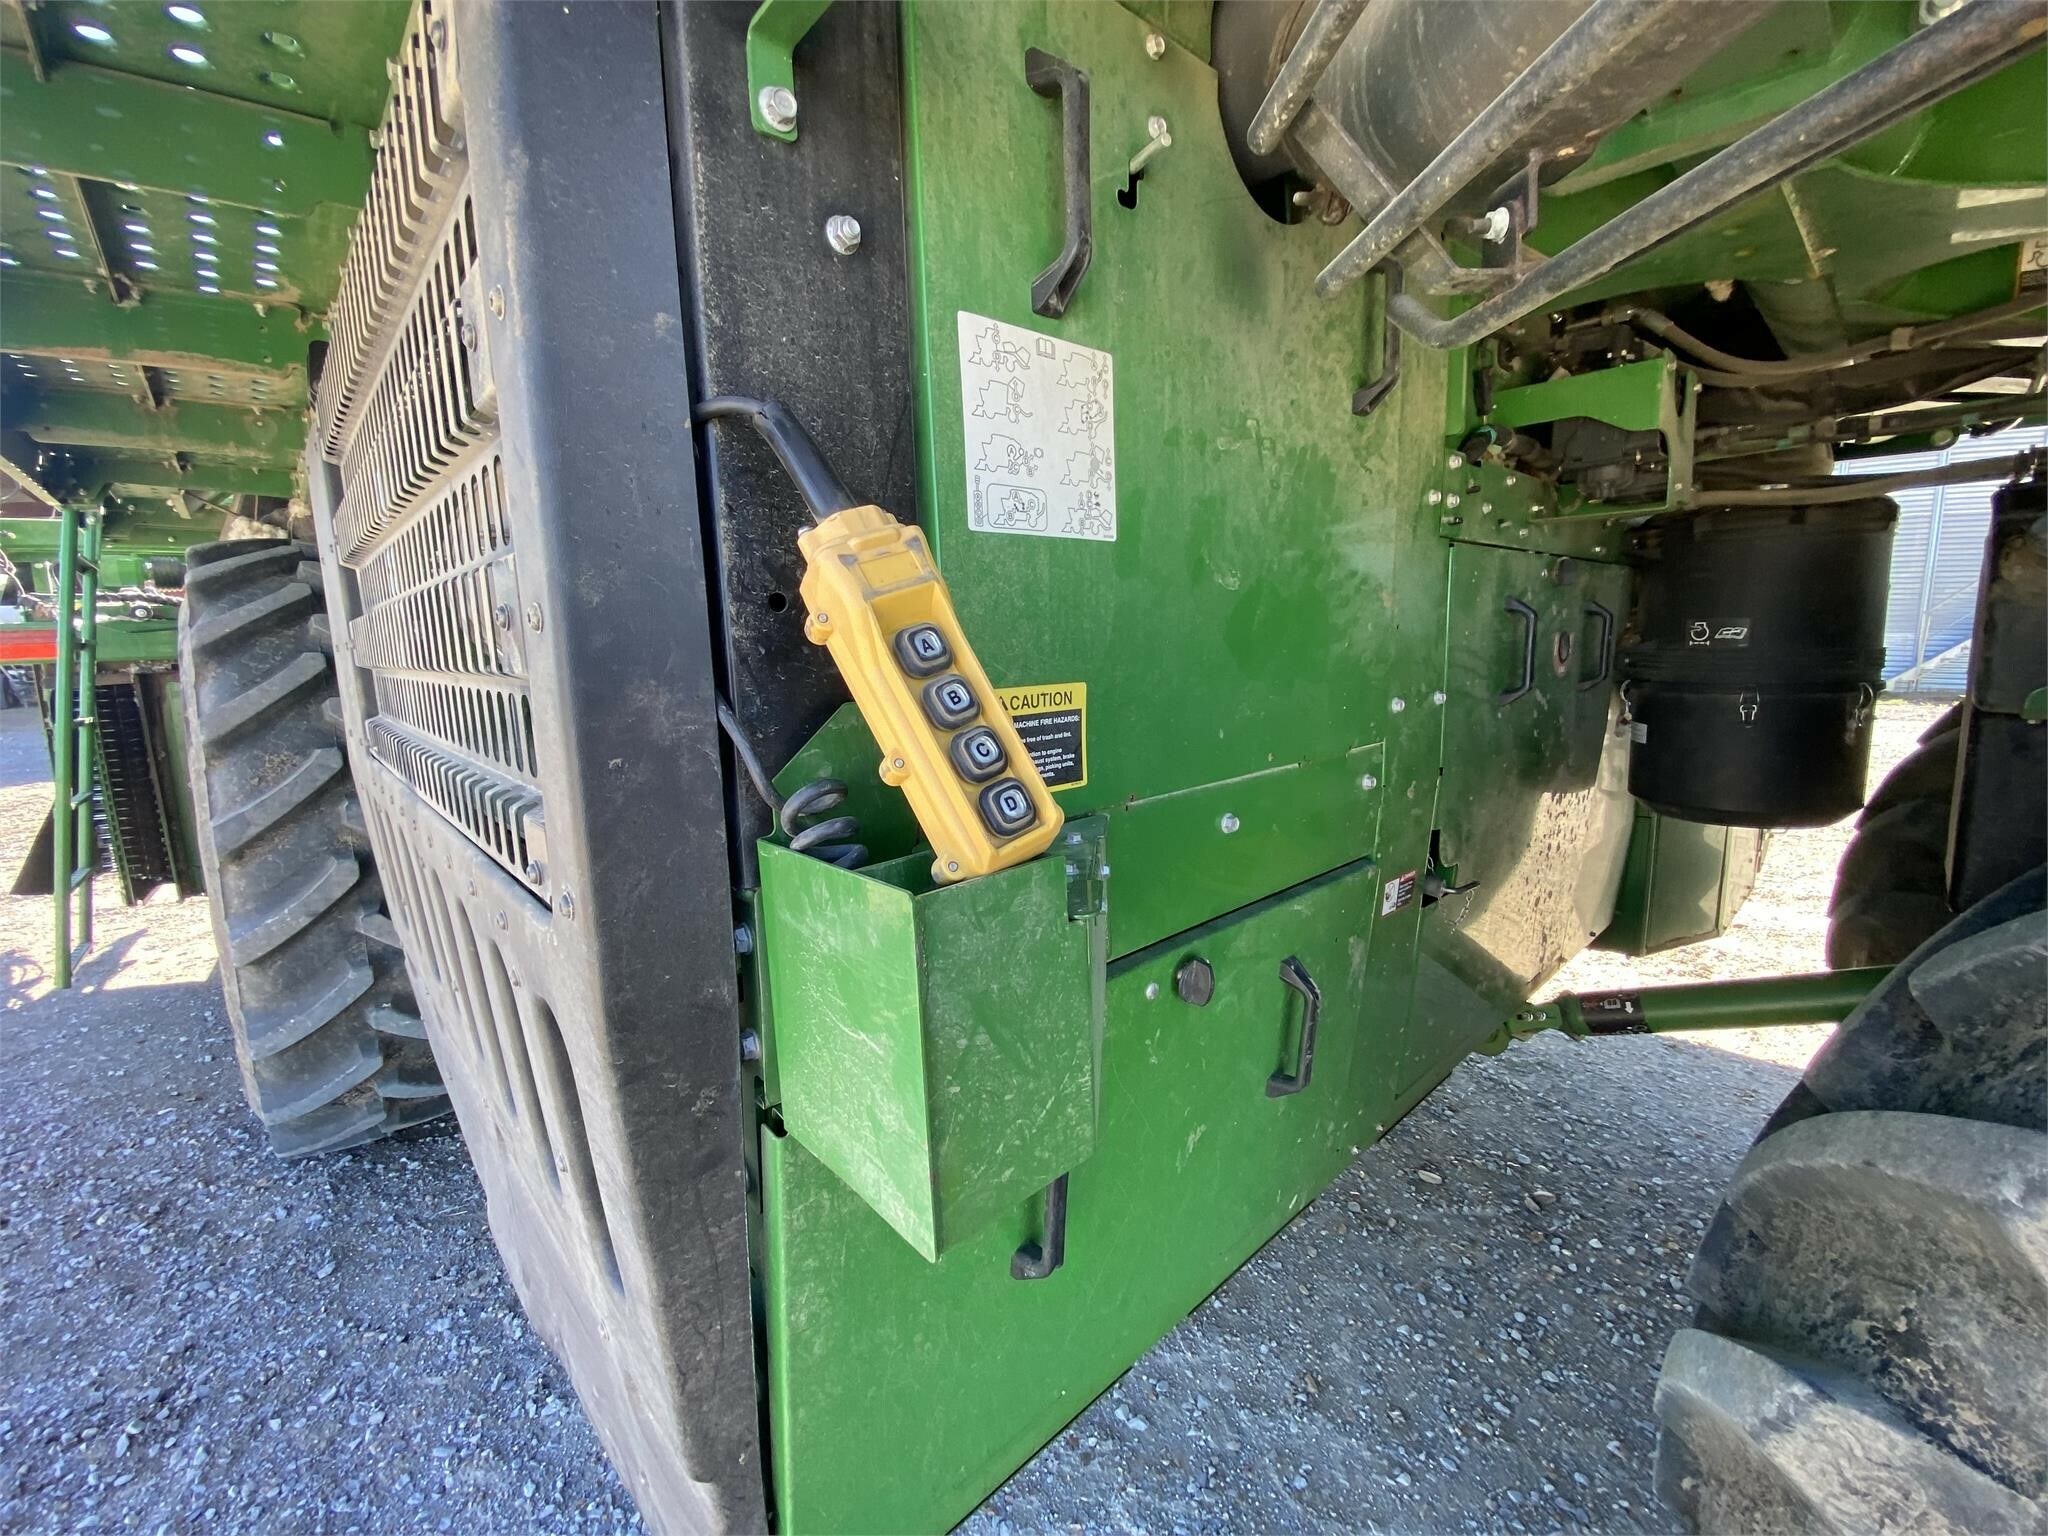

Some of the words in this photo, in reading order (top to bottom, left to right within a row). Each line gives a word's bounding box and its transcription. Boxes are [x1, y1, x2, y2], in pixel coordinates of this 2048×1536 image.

[921, 638, 934, 653] A
[947, 690, 962, 706] B
[1010, 691, 1072, 710] CAUTION
[1054, 715, 1080, 724] HAZARDS:
[976, 742, 990, 757] C
[1004, 796, 1018, 811] D
